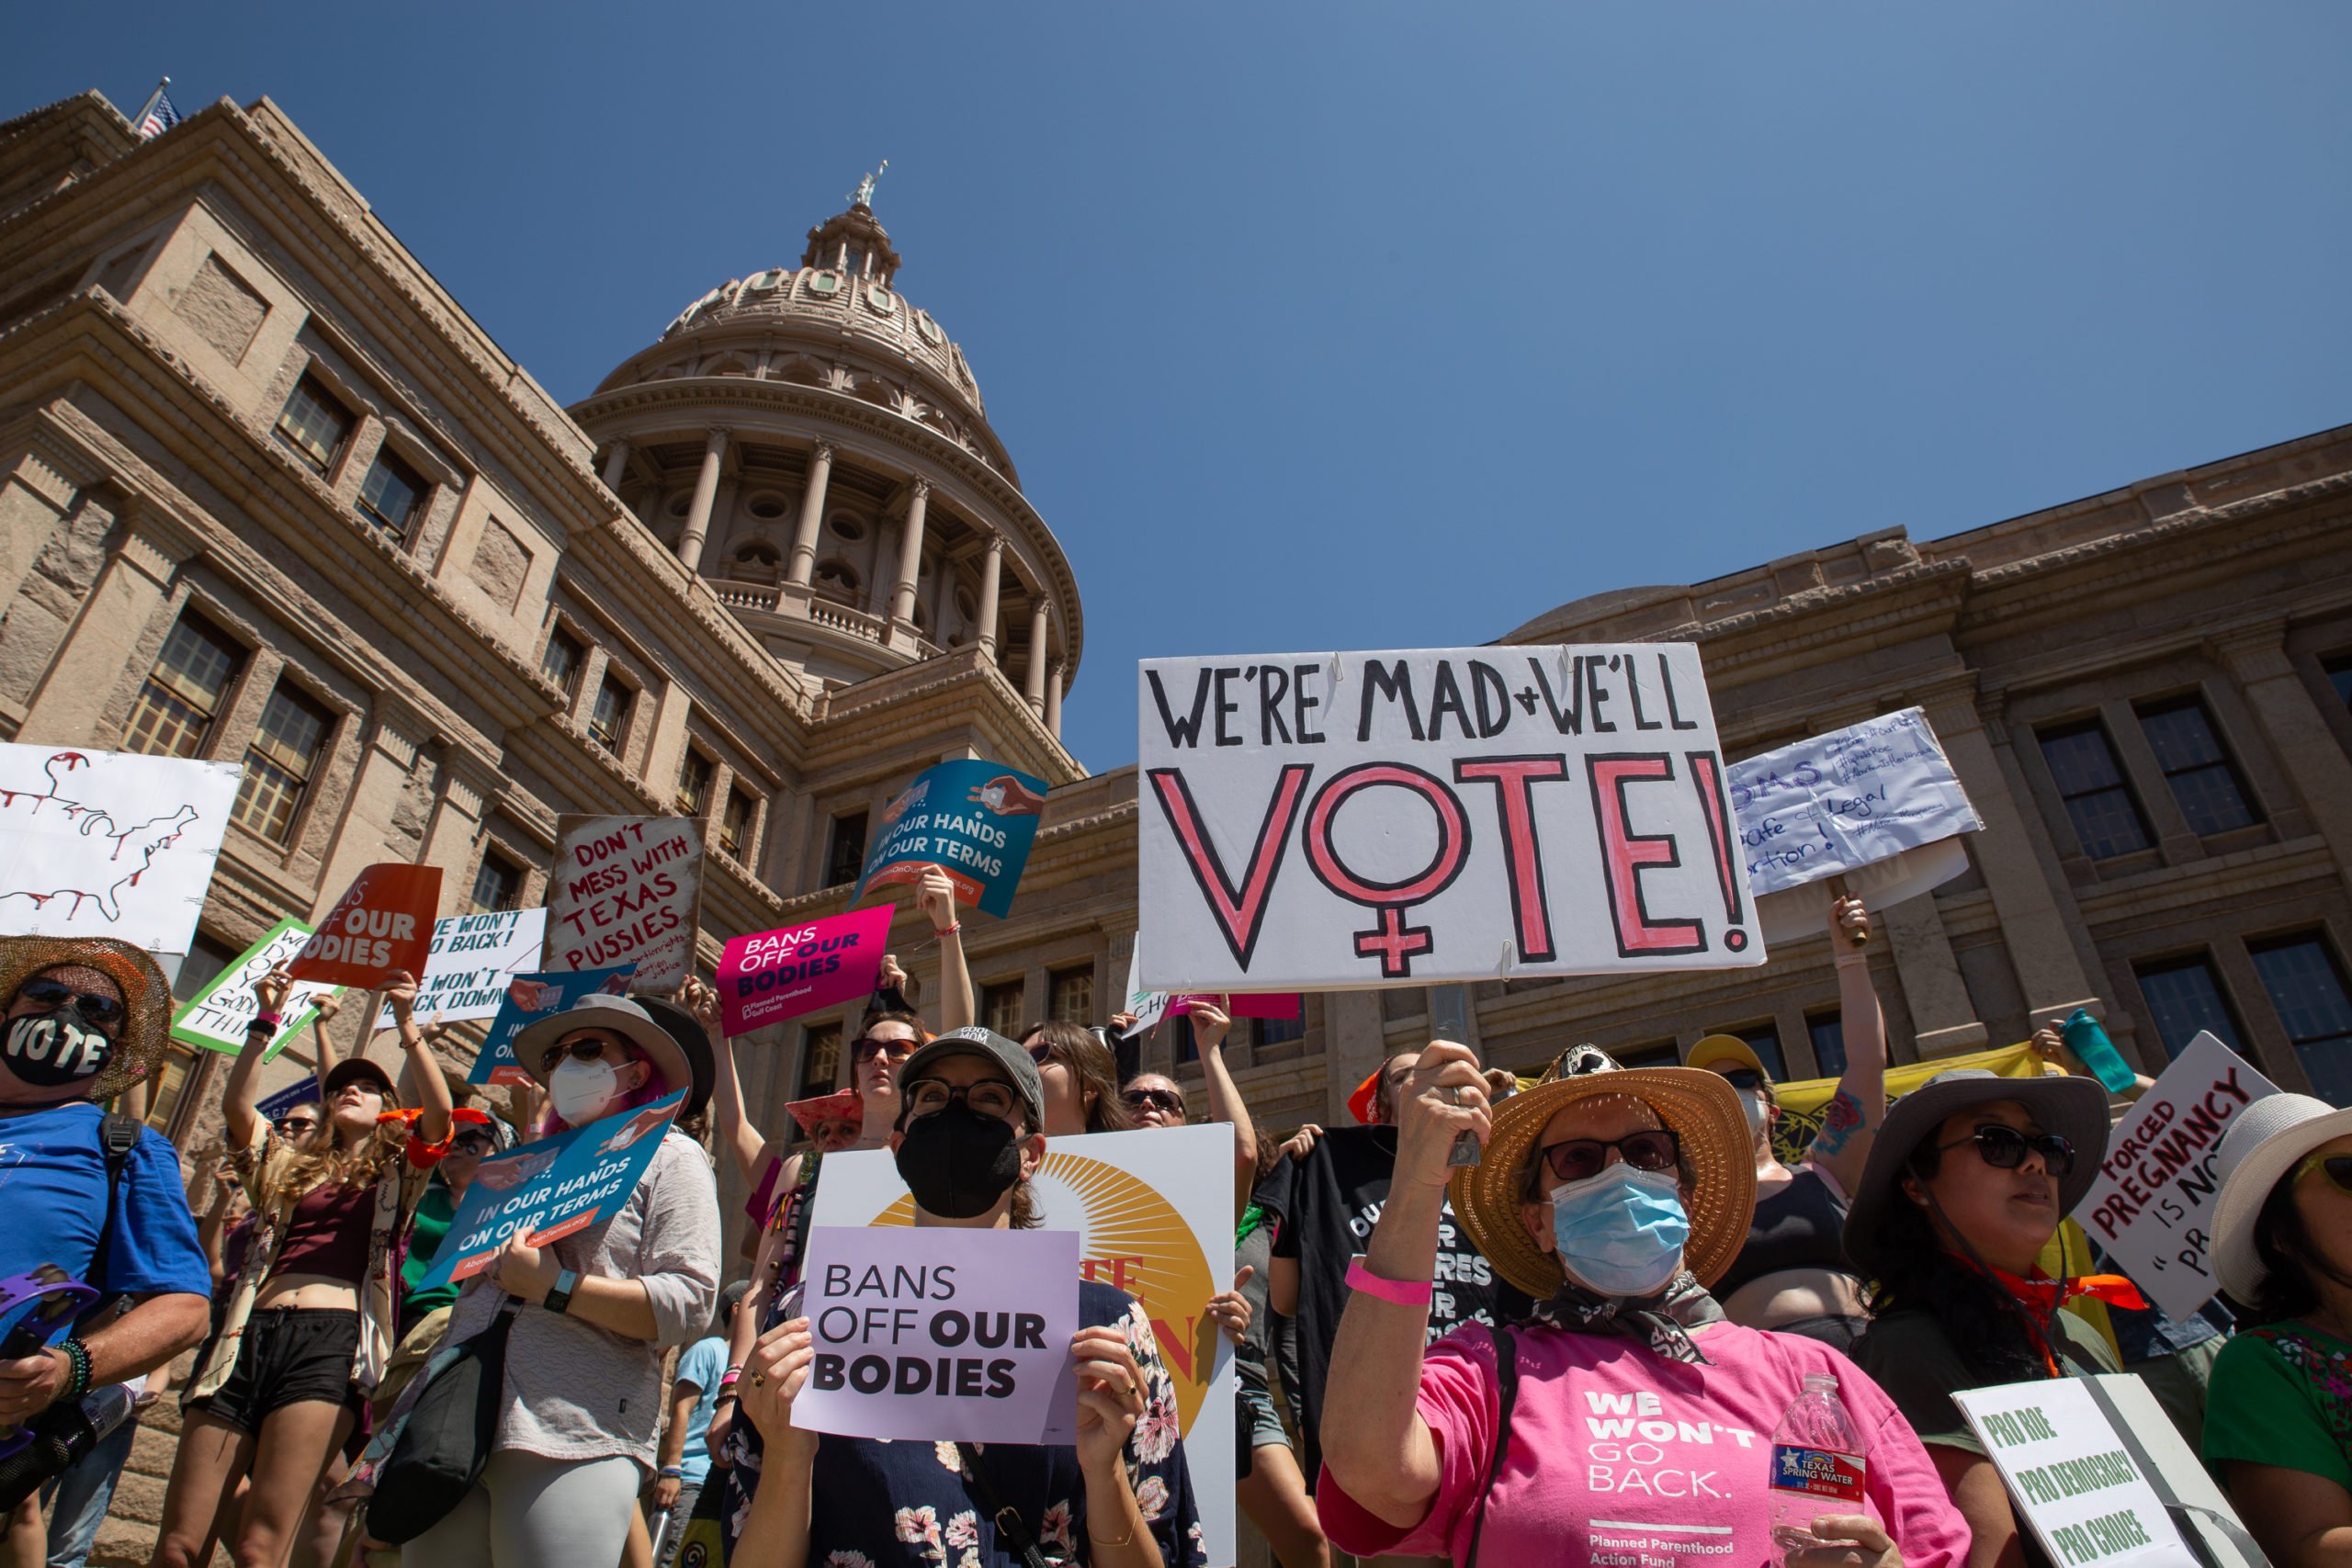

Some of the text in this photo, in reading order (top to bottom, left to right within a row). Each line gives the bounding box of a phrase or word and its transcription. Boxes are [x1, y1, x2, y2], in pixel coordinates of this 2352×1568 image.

[1145, 664, 1326, 749] WE'RE
[1356, 660, 1511, 742] MAD
[1527, 653, 1699, 736] WE'LL
[1730, 761, 1822, 814] OMS
[878, 813, 1007, 851] IN OUR HANDS
[1741, 818, 1786, 846] afe
[1827, 784, 1886, 818] Legal
[574, 822, 644, 867] DON'T
[868, 837, 1002, 877] ON OUR TERMS
[568, 834, 689, 904] MESS WITH
[1145, 750, 1749, 978] VOTE!
[458, 911, 524, 933] WON'T
[562, 873, 678, 938] TEXAS
[345, 908, 415, 942] OUR
[429, 931, 514, 954] O BACK!
[565, 906, 680, 972] PUSSIES
[744, 926, 818, 955] BANS
[302, 934, 392, 968] ODIES
[739, 932, 861, 973] OFF OUR
[430, 967, 501, 991] WON'T
[737, 953, 842, 998] BODIES
[447, 987, 503, 1010] DOWN
[750, 985, 813, 1010] Planned Parenthood
[764, 1003, 784, 1013] Coast
[6, 1017, 107, 1075] VOTE
[959, 1032, 989, 1044] MOM
[960, 1026, 990, 1036] COOL
[2090, 1066, 2251, 1241] PREGNANCY
[2101, 1100, 2176, 1181] FORCED
[475, 1156, 632, 1225] IN OUR HANDS
[458, 1179, 624, 1252] ON OUR TERMS
[2152, 1198, 2186, 1229] IS
[823, 1264, 956, 1301] BANS
[818, 1305, 1047, 1349] OFF OUR
[812, 1353, 1017, 1399] BODIES
[1584, 1391, 1663, 1416] WE
[1585, 1417, 1756, 1449] WON'T
[1981, 1406, 2058, 1449] PRO ROE
[1588, 1442, 1664, 1465] GO
[1802, 1460, 1835, 1472] TEXAS
[1589, 1464, 1732, 1498] BACK.
[1782, 1466, 1853, 1485] SPRING WATER
[2016, 1450, 2140, 1506] PRO DEMOCRACY
[1589, 1534, 1734, 1555] Planned Parenthood
[2051, 1508, 2152, 1566] PRO CHOICE
[1590, 1552, 1675, 1568] Action Fund
